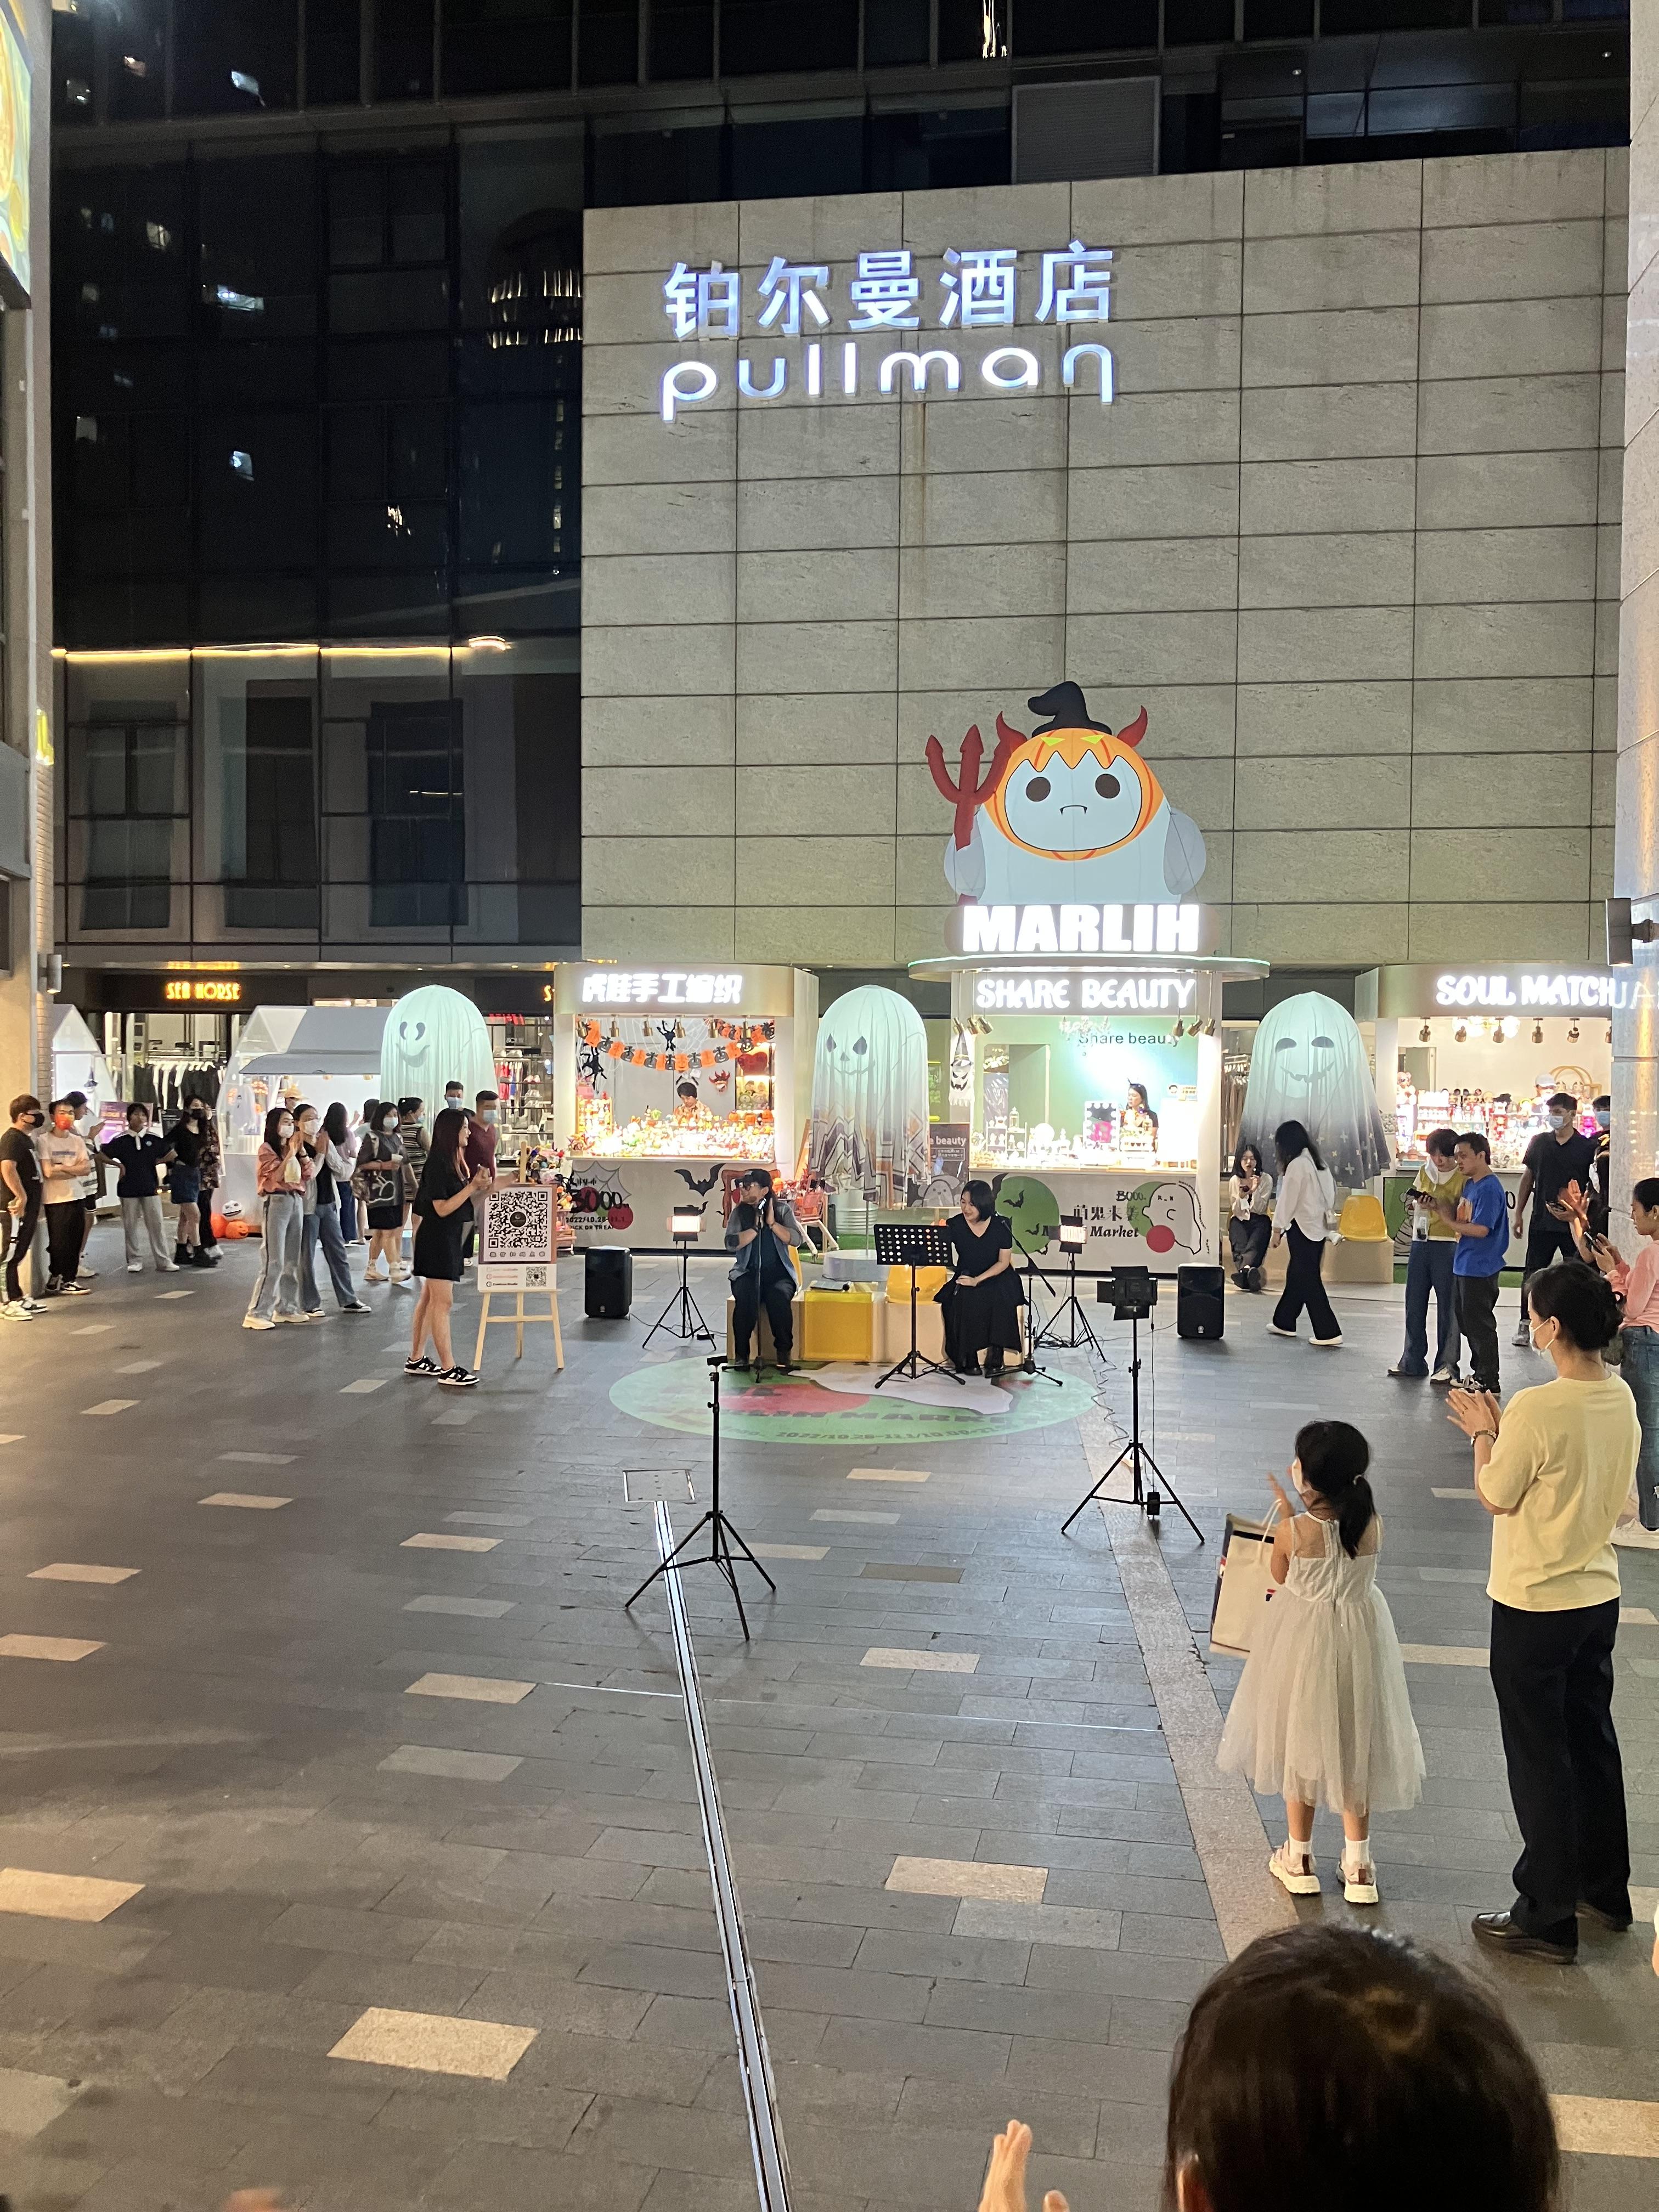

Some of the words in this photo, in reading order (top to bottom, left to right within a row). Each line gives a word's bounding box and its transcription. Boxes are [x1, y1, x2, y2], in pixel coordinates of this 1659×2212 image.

[663, 240, 1114, 341] 铂尔曼酒店
[661, 341, 1114, 423] pullman
[962, 904, 1200, 952] MARLIH
[976, 978, 1070, 1009] SHARE
[1082, 978, 1197, 1009] BEAUTY
[1436, 975, 1516, 1005] SOUL
[1079, 1032, 1124, 1044] Share
[936, 1136, 967, 1147] beauty
[1090, 1224, 1139, 1238] Market
